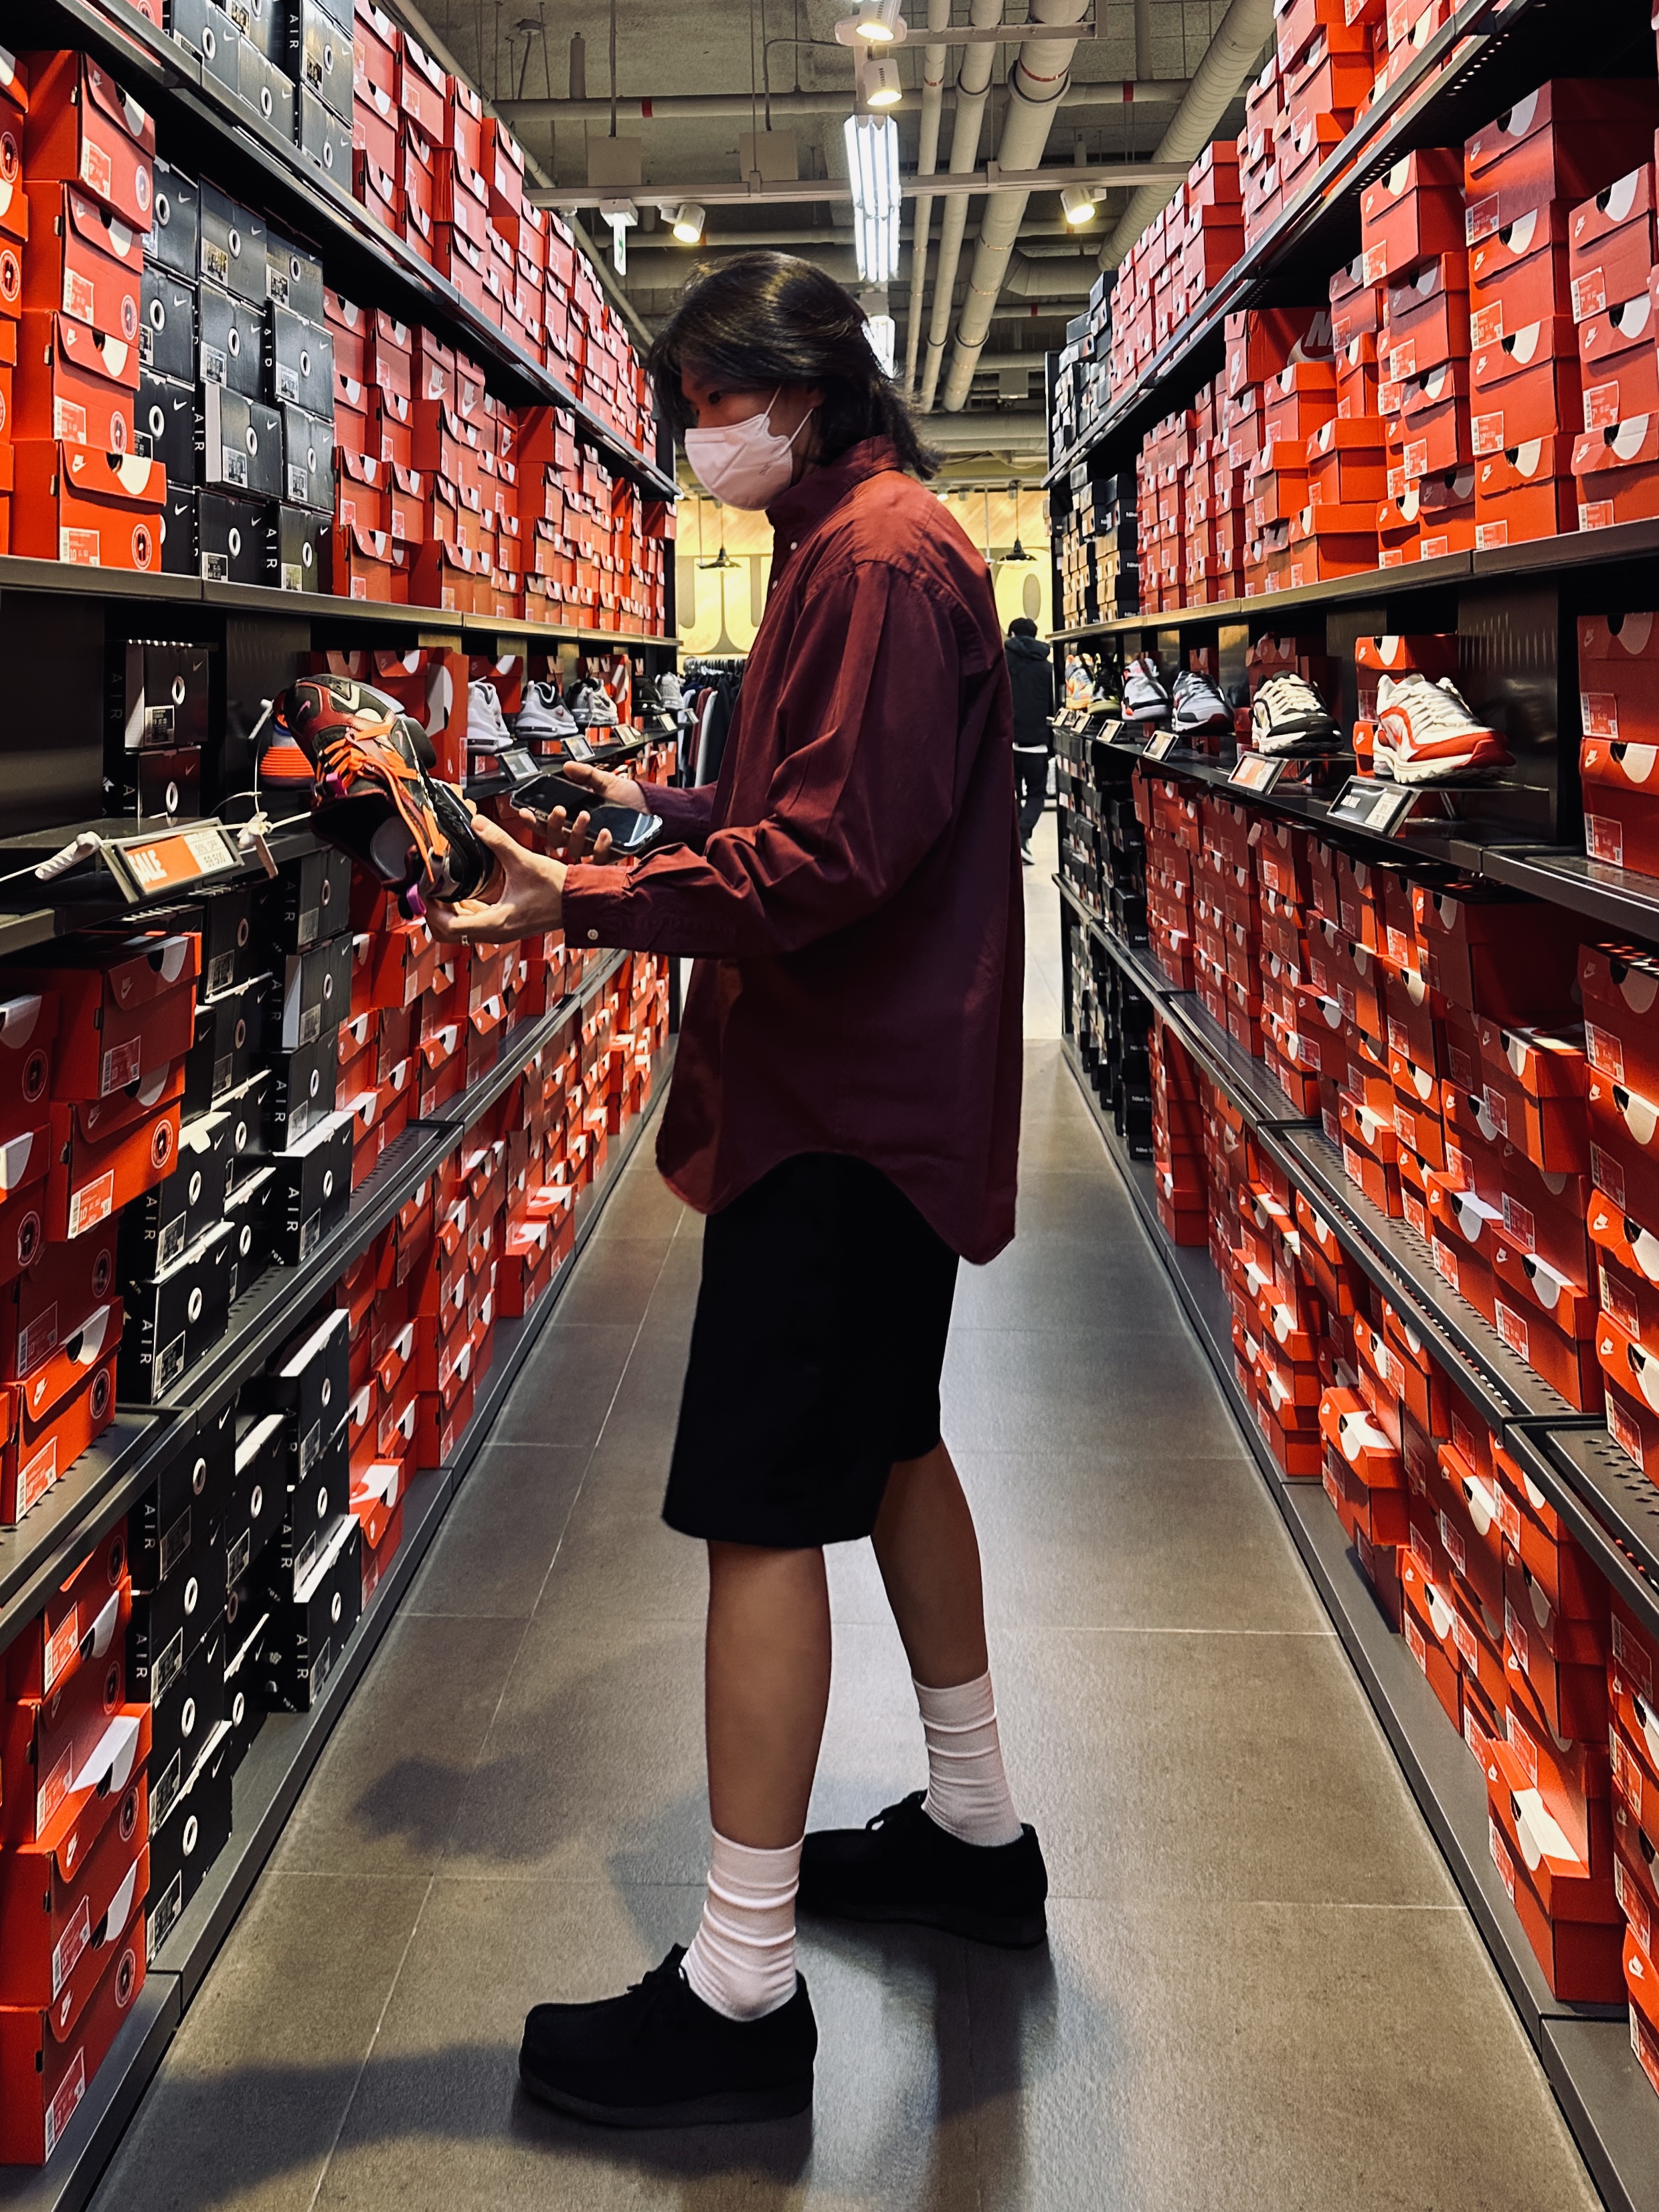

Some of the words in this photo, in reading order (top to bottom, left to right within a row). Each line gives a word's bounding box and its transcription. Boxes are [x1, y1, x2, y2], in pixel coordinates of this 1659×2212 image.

[289, 14, 299, 49] AIR
[194, 413, 205, 451] AIR
[266, 527, 278, 568] AIR
[110, 673, 122, 719] AIR
[270, 979, 282, 1021] AIR
[274, 1080, 287, 1122] AIR
[144, 1196, 157, 1240] AIR
[286, 1187, 299, 1231] AIR
[140, 1319, 153, 1364] AIR
[145, 1504, 156, 1549] AIR
[281, 1524, 293, 1569] AIR
[136, 1633, 148, 1679] AIR
[296, 1634, 309, 1680] AIR
